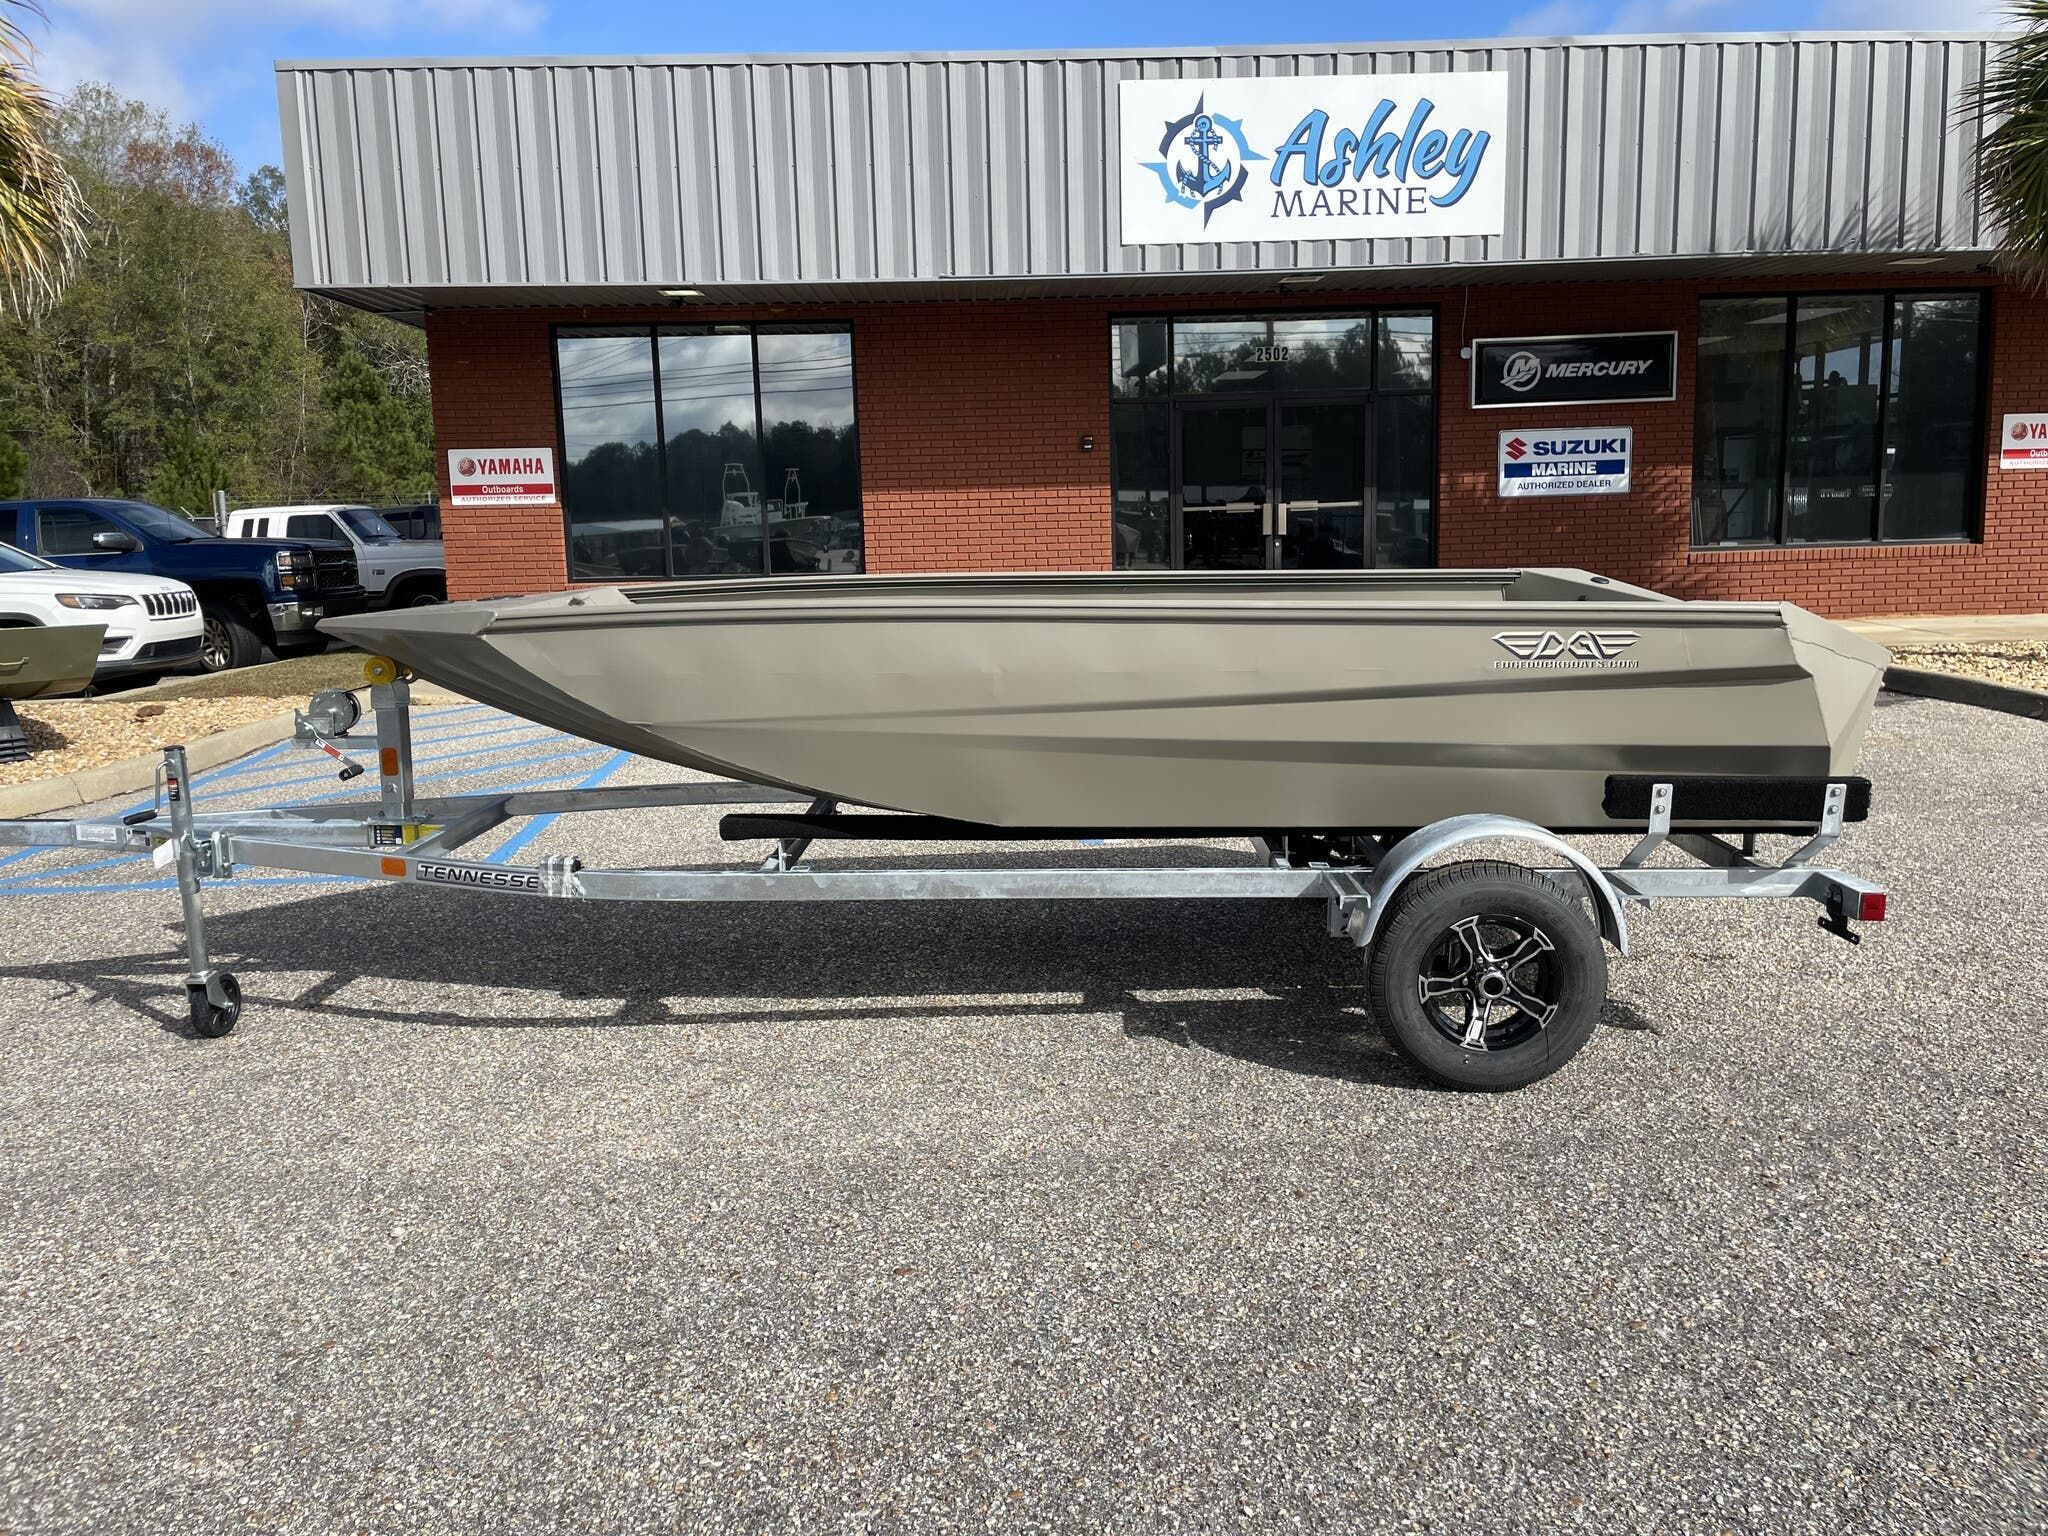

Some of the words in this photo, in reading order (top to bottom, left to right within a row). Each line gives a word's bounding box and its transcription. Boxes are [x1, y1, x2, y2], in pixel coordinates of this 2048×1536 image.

[1270, 98, 1491, 208] Ashley
[1270, 187, 1427, 217] MARINE
[1256, 347, 1289, 361] 2502
[1545, 359, 1653, 378] MERCURY
[1533, 438, 1626, 456] SUZUKI
[476, 458, 544, 475] YAMAHA
[1531, 461, 1597, 477] MARINE
[481, 485, 524, 494] Outboards
[1517, 480, 1574, 491] AUTHORIZED
[1576, 479, 1612, 489] DEALER
[1494, 660, 1640, 669] EDGEDUCKBOATS.COM
[420, 865, 540, 889] TENNESSE
